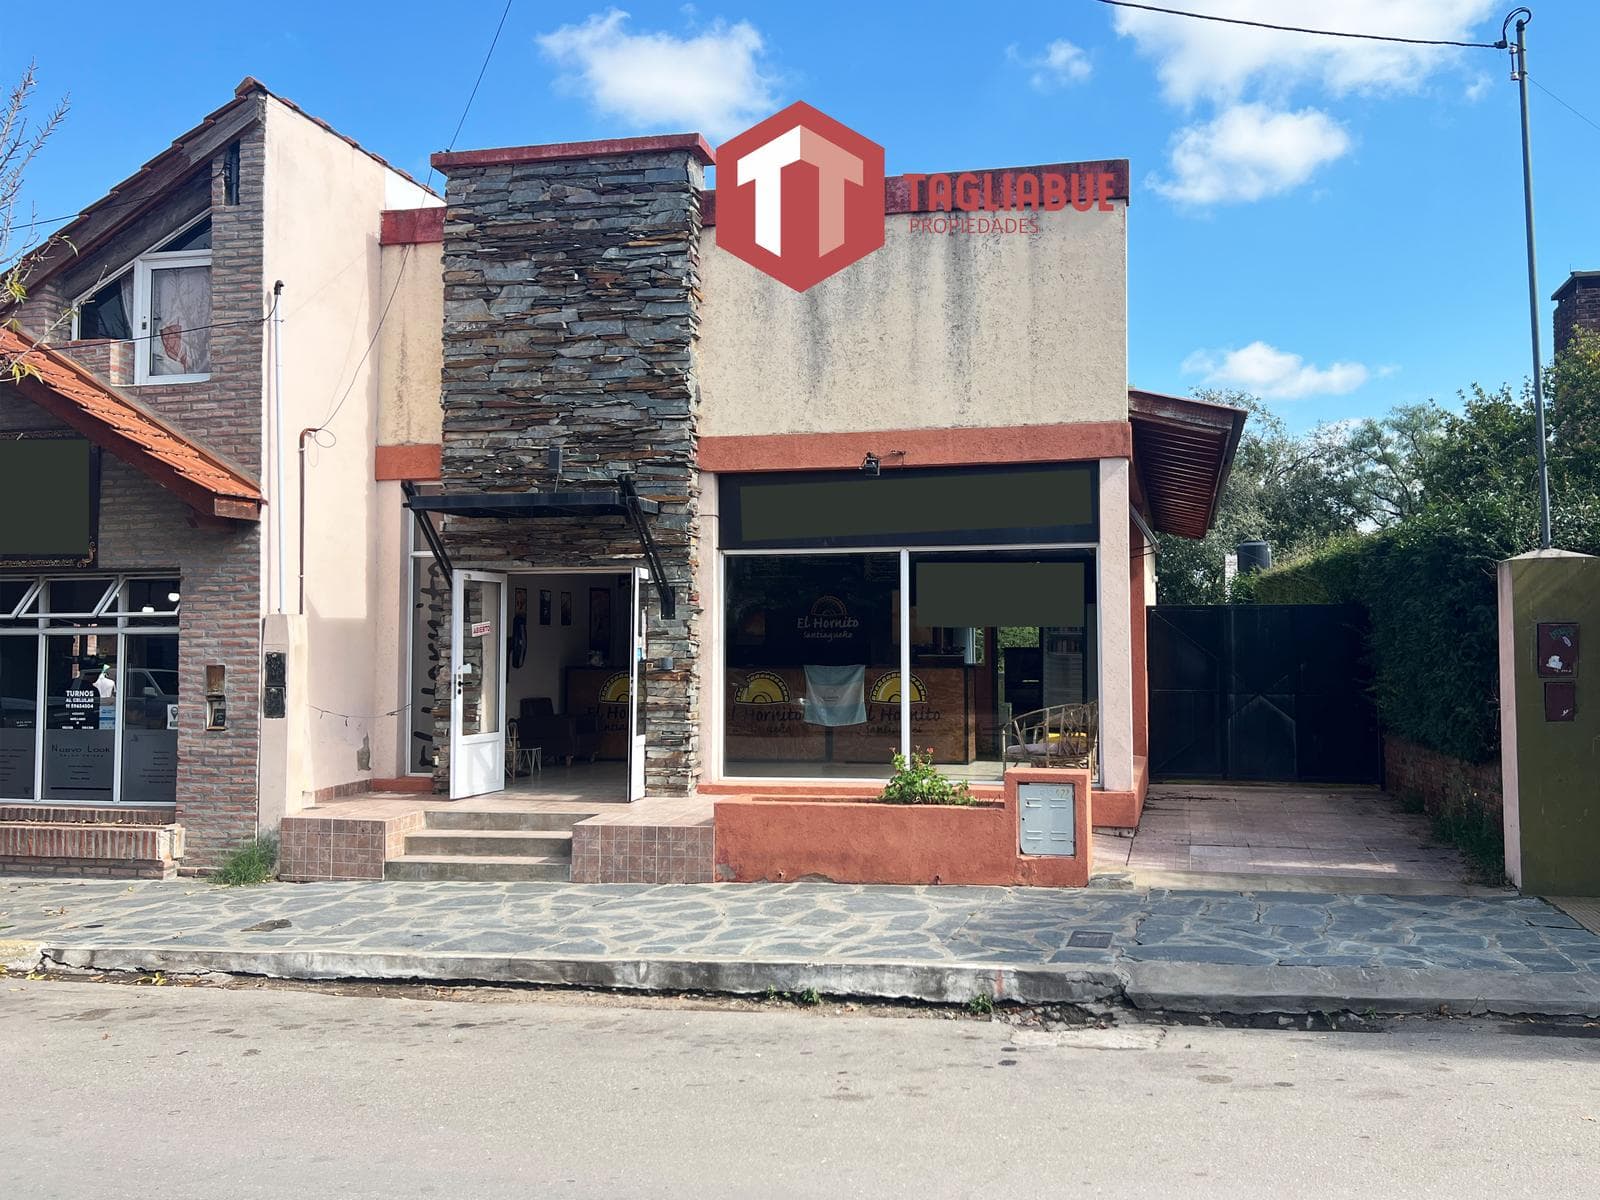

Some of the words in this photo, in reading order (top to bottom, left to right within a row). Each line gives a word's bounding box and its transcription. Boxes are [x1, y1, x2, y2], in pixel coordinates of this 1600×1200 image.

[797, 616, 811, 628] El
[813, 616, 859, 628] Hornito
[52, 744, 81, 753] Nuevo
[87, 744, 110, 753] Look
